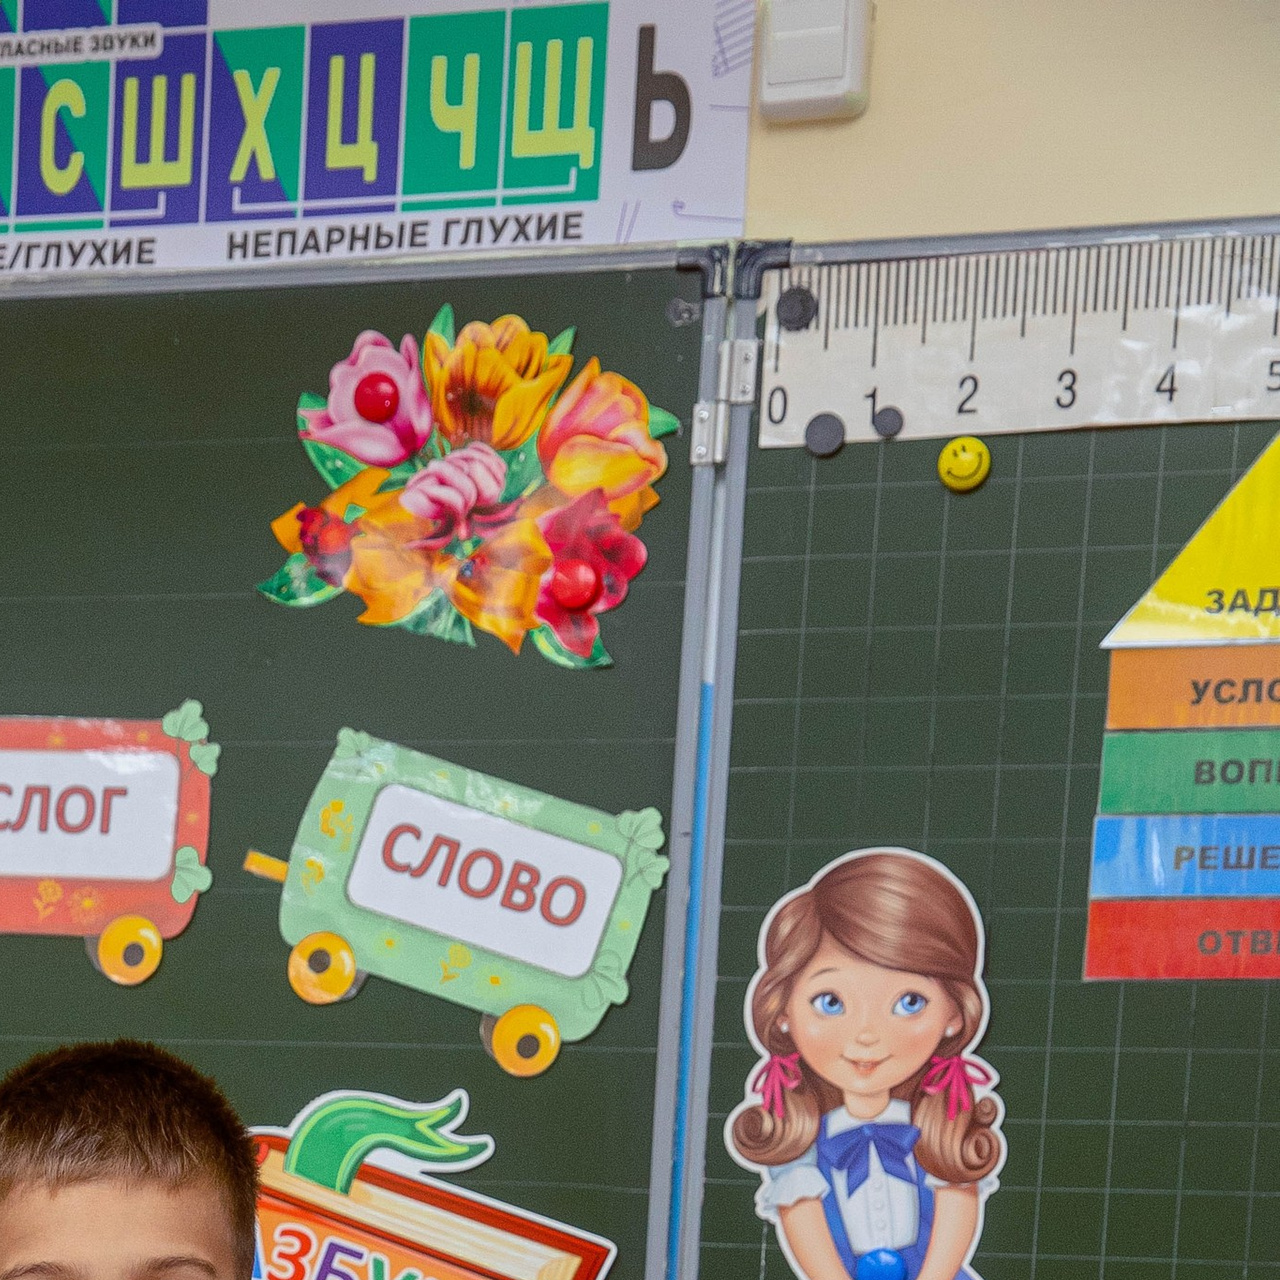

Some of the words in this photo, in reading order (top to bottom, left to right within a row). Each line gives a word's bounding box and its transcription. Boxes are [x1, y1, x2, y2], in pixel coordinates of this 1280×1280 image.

[90, 31, 155, 52] ЗВУКИ
[40, 79, 86, 195] С
[120, 73, 197, 191] Ш
[229, 67, 281, 182] Х
[326, 53, 378, 183] Ц
[431, 53, 480, 170] Ч
[512, 36, 595, 169] Щ
[631, 23, 692, 172] Ь
[227, 220, 429, 261] НЕПАРНЫЕ
[443, 211, 583, 248] ГЛУХИЕ
[767, 386, 788, 425] 0
[864, 387, 879, 427] 1
[957, 374, 979, 415] 2
[1056, 369, 1078, 409] 3
[1155, 364, 1177, 402] 4
[1194, 758, 1280, 786] ВОП
[382, 823, 586, 927] СЛОВО
[1198, 930, 1280, 955] ОТВ
